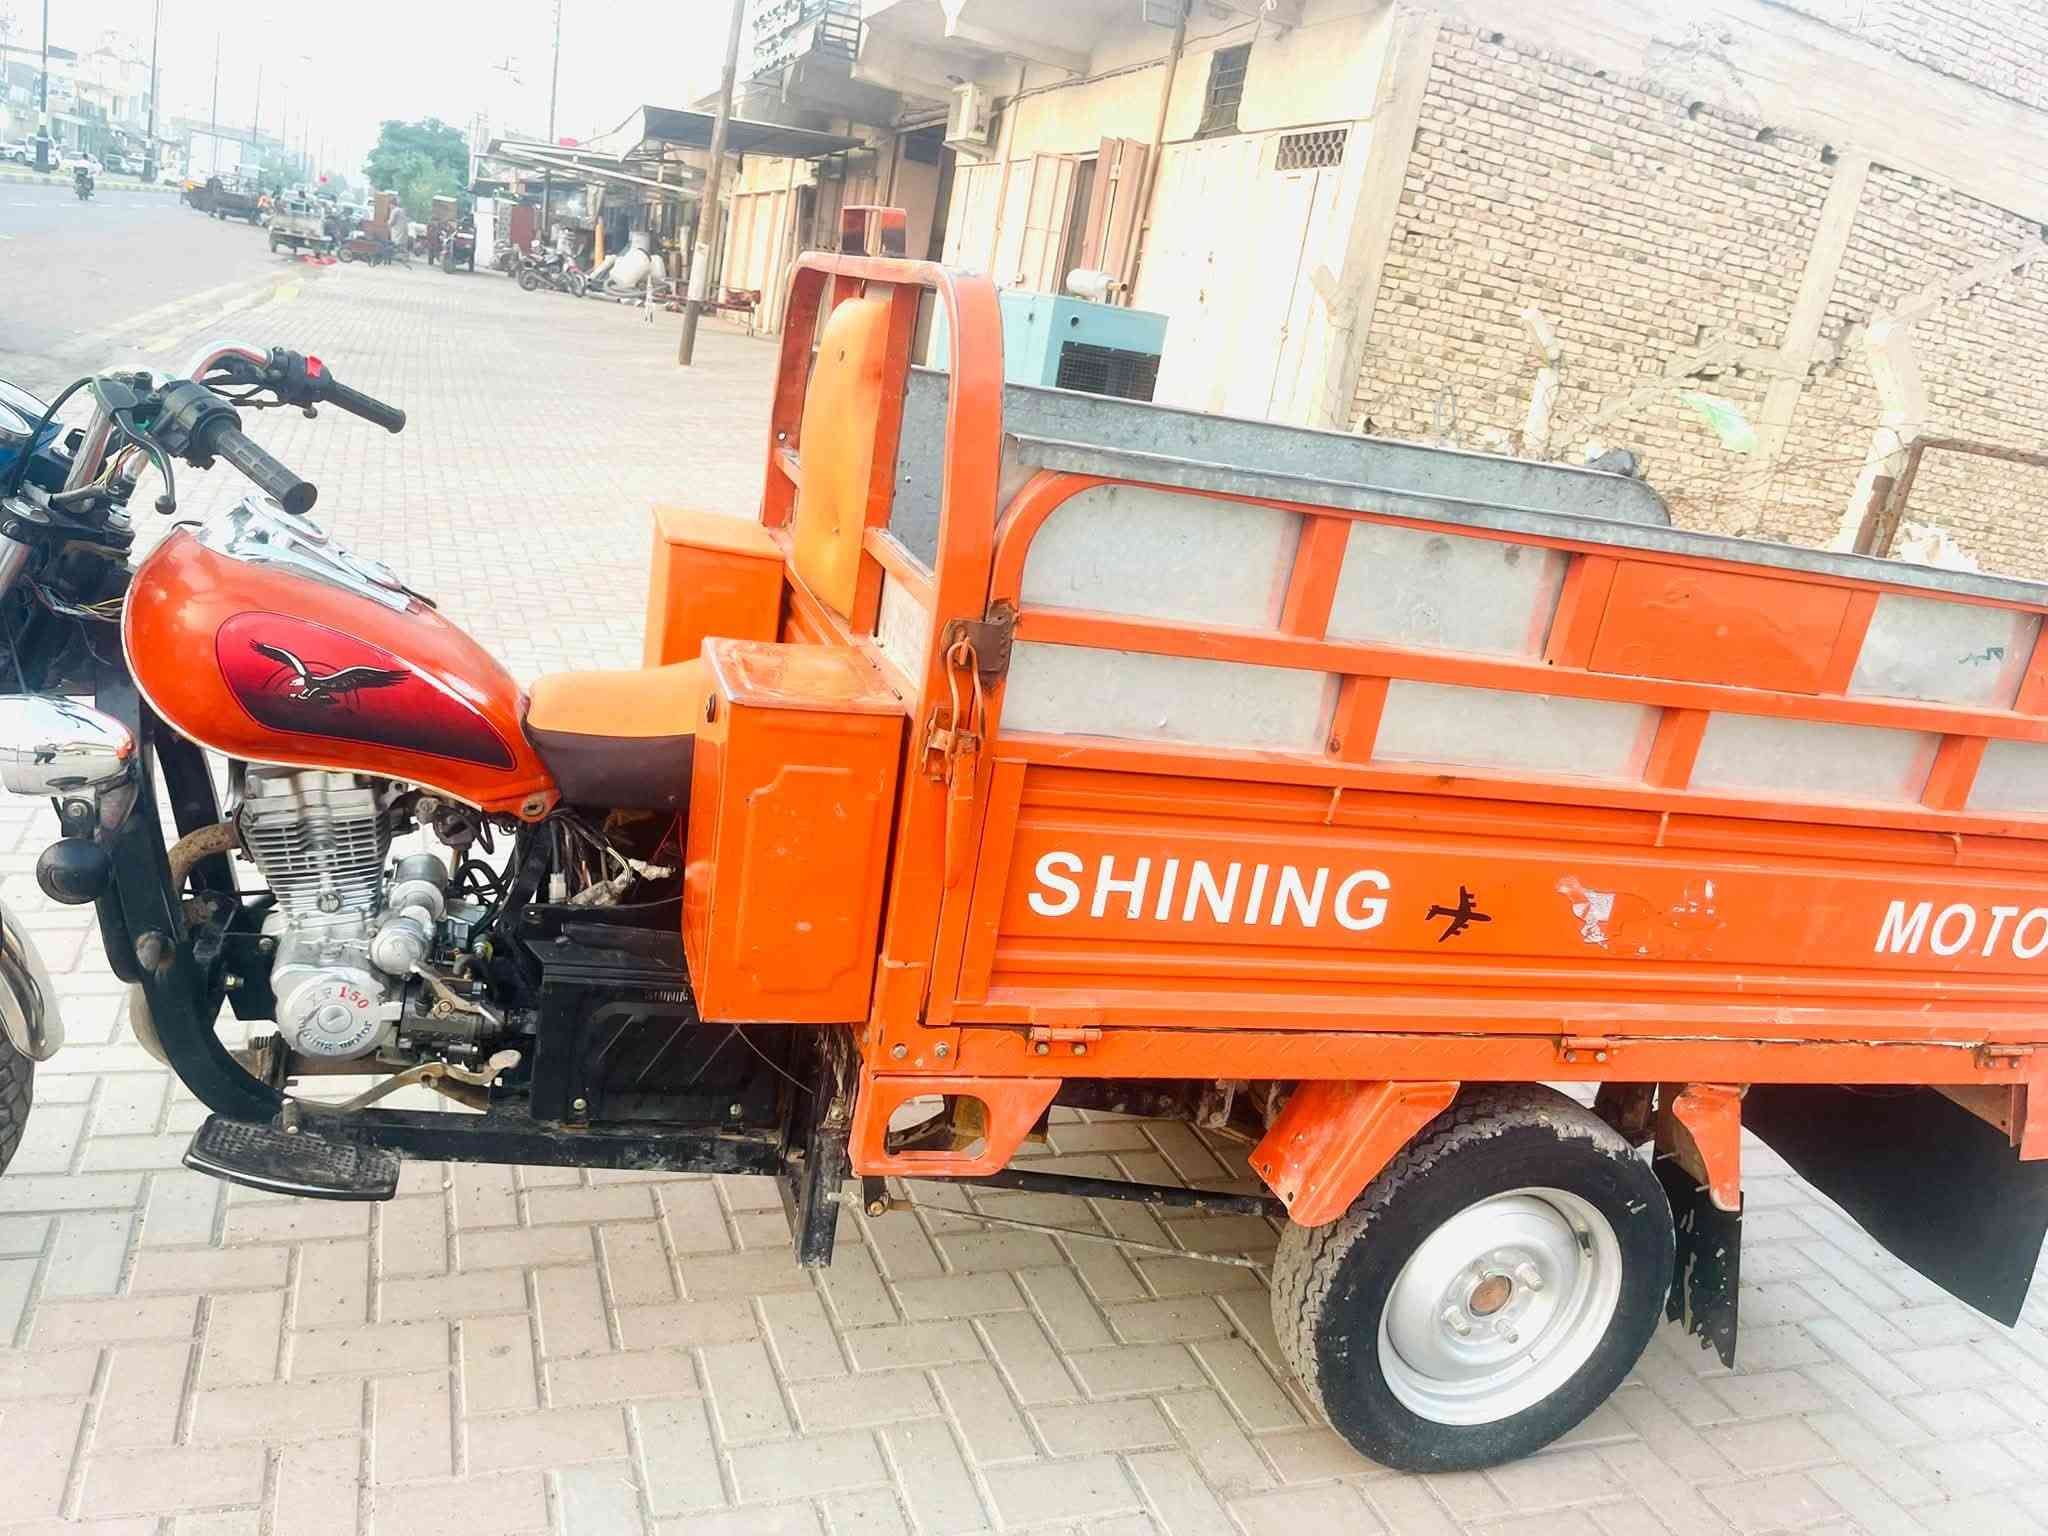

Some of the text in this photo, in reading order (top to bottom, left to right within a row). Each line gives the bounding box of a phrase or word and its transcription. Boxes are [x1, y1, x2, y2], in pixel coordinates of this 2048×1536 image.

[1028, 850, 2048, 960] SHINING MOTO
[338, 984, 369, 1009] 150
